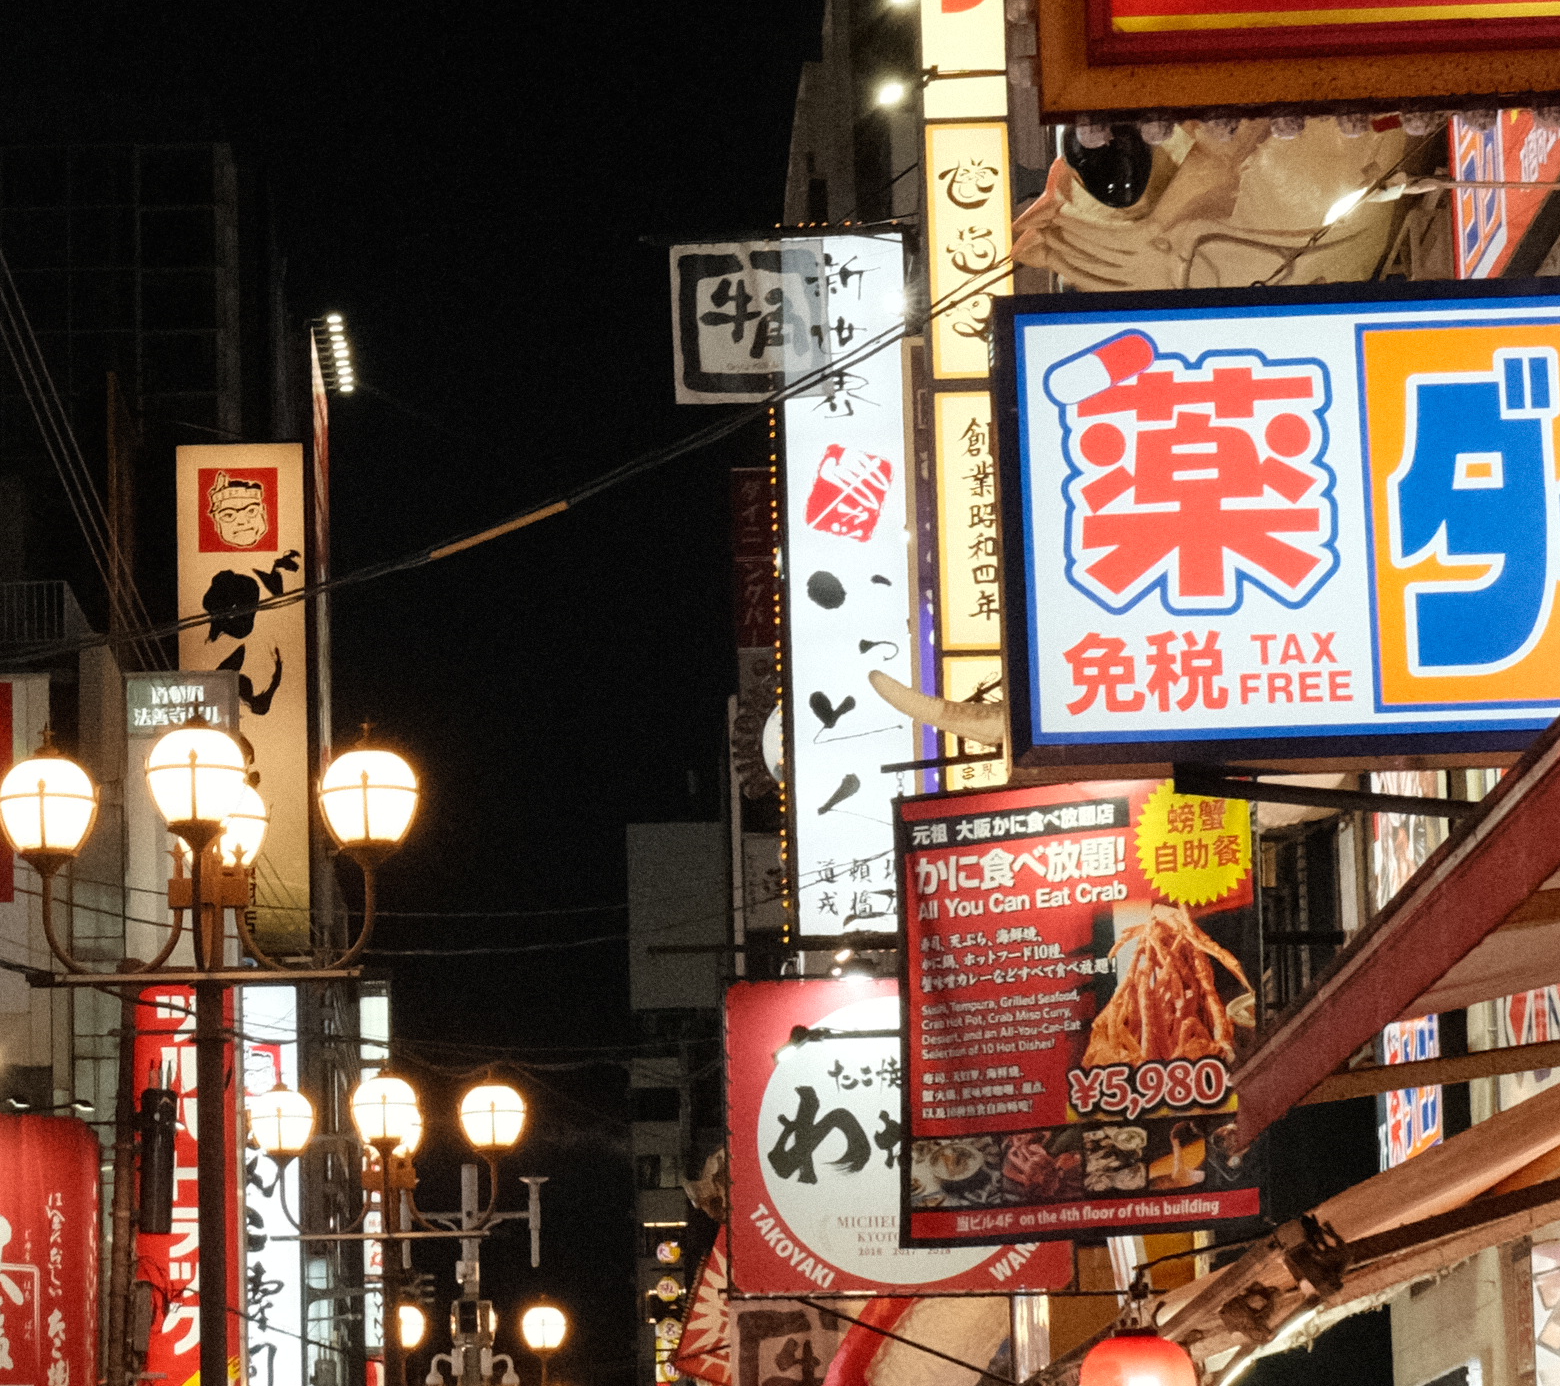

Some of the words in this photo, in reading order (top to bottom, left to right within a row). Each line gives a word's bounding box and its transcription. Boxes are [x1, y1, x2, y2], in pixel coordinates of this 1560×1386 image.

[1080, 365, 1321, 598] 薬
[1250, 631, 1340, 666] TAX
[1063, 630, 1230, 717] 免税
[1238, 670, 1356, 705] FREE
[912, 823, 949, 846] 元祖
[955, 803, 1115, 841] 大阪かに食べ放題店
[1165, 799, 1227, 833] 螃蟹
[914, 835, 1128, 896] かに食べ放題!
[1154, 839, 1241, 873] 自助餐
[917, 899, 939, 922] All
[944, 894, 985, 919] You
[989, 891, 1031, 913] Can
[1036, 887, 1072, 909] Eat
[1076, 880, 1128, 905] Crab
[1000, 993, 1033, 1008] Grilled
[1036, 989, 1081, 1005] Seafood,
[989, 1011, 1014, 1026] Crab
[1015, 1008, 1040, 1023] Miso
[994, 1041, 1015, 1054] Hot
[1017, 1037, 1056, 1052] Dishes!
[1068, 1059, 1228, 1120] ¥5,980
[955, 1212, 1014, 1233] 当ビル4F
[1017, 1211, 1034, 1225] on
[1034, 1209, 1057, 1224] the
[1058, 1207, 1080, 1222] 4th
[1081, 1205, 1115, 1221] floor
[1117, 1203, 1133, 1218] of
[1134, 1201, 1159, 1217] this
[1162, 1197, 1220, 1219] building
[749, 1201, 837, 1289] TAKOYAKI
